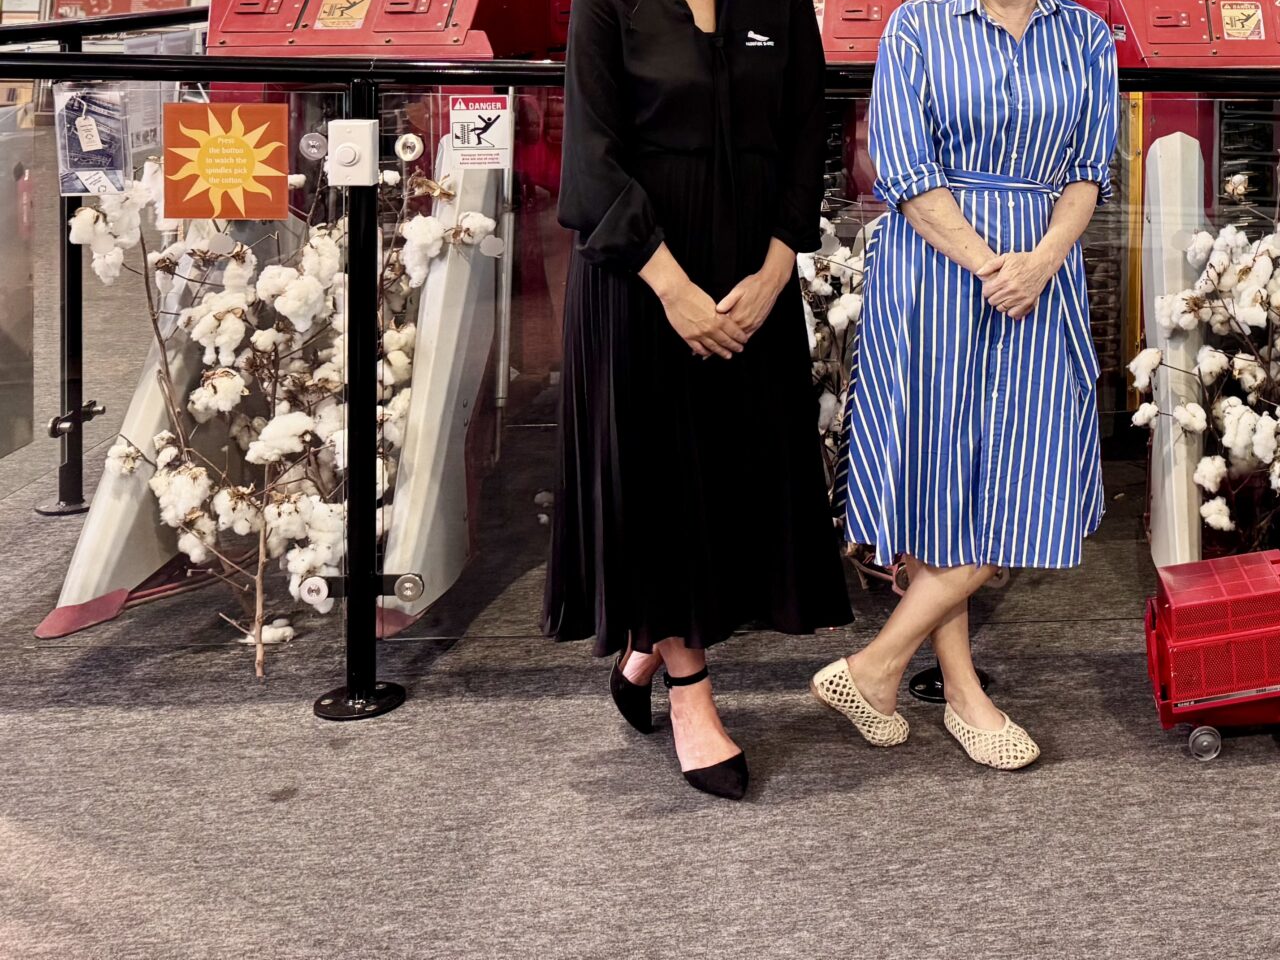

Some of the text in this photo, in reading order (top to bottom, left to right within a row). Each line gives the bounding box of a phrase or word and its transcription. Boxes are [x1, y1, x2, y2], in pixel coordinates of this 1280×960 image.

[468, 102, 502, 110] DANGER
[205, 167, 248, 175] spindles pick
